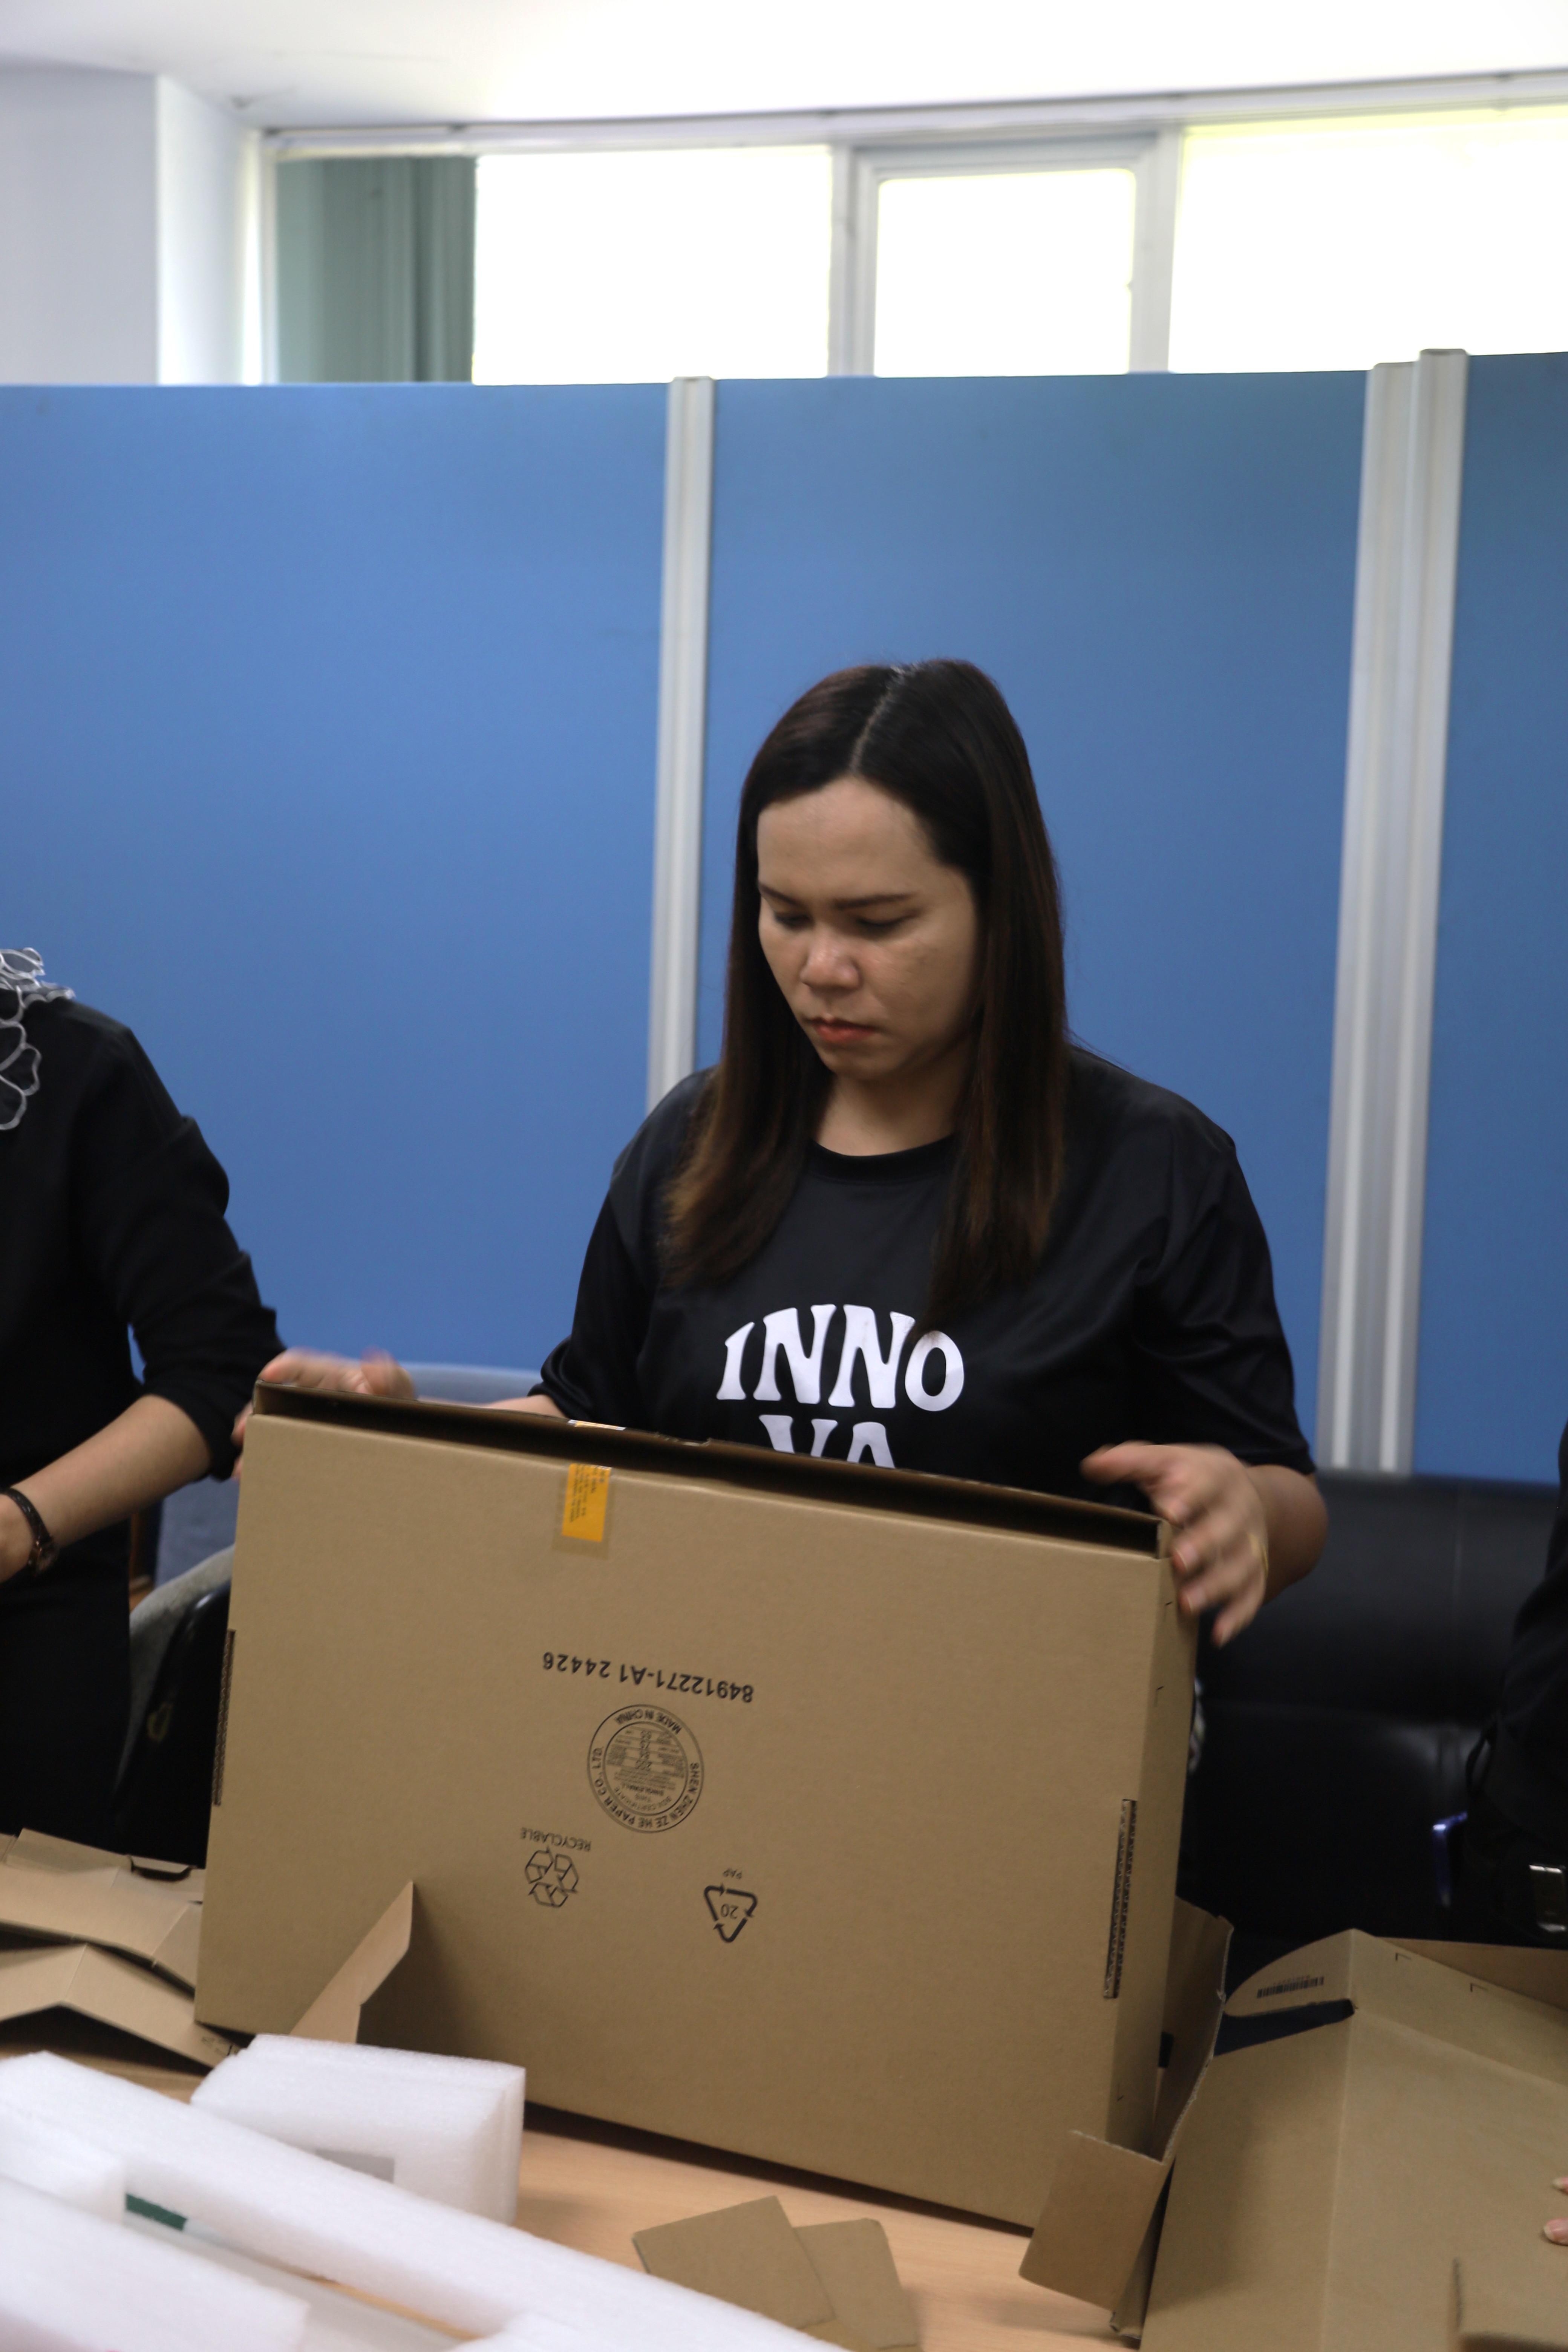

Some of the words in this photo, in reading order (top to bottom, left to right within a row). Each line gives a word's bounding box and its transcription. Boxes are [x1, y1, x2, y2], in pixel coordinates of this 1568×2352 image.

[717, 1304, 964, 1411] INNO
[543, 1652, 611, 1678] 24426
[619, 1664, 753, 1703] 84912271-A1
[614, 1709, 643, 1724] CHINA
[645, 1710, 654, 1719] IN
[657, 1712, 682, 1735] MADE
[688, 1762, 699, 1793] SHEN
[604, 1796, 635, 1825] PAPER
[670, 1795, 692, 1821] ZHEN
[638, 1817, 652, 1828] HE
[655, 1815, 669, 1828] ZE
[521, 1827, 591, 1851] RECYCLABLE
[723, 1868, 742, 1879] PAP
[720, 1904, 739, 1919] 20
